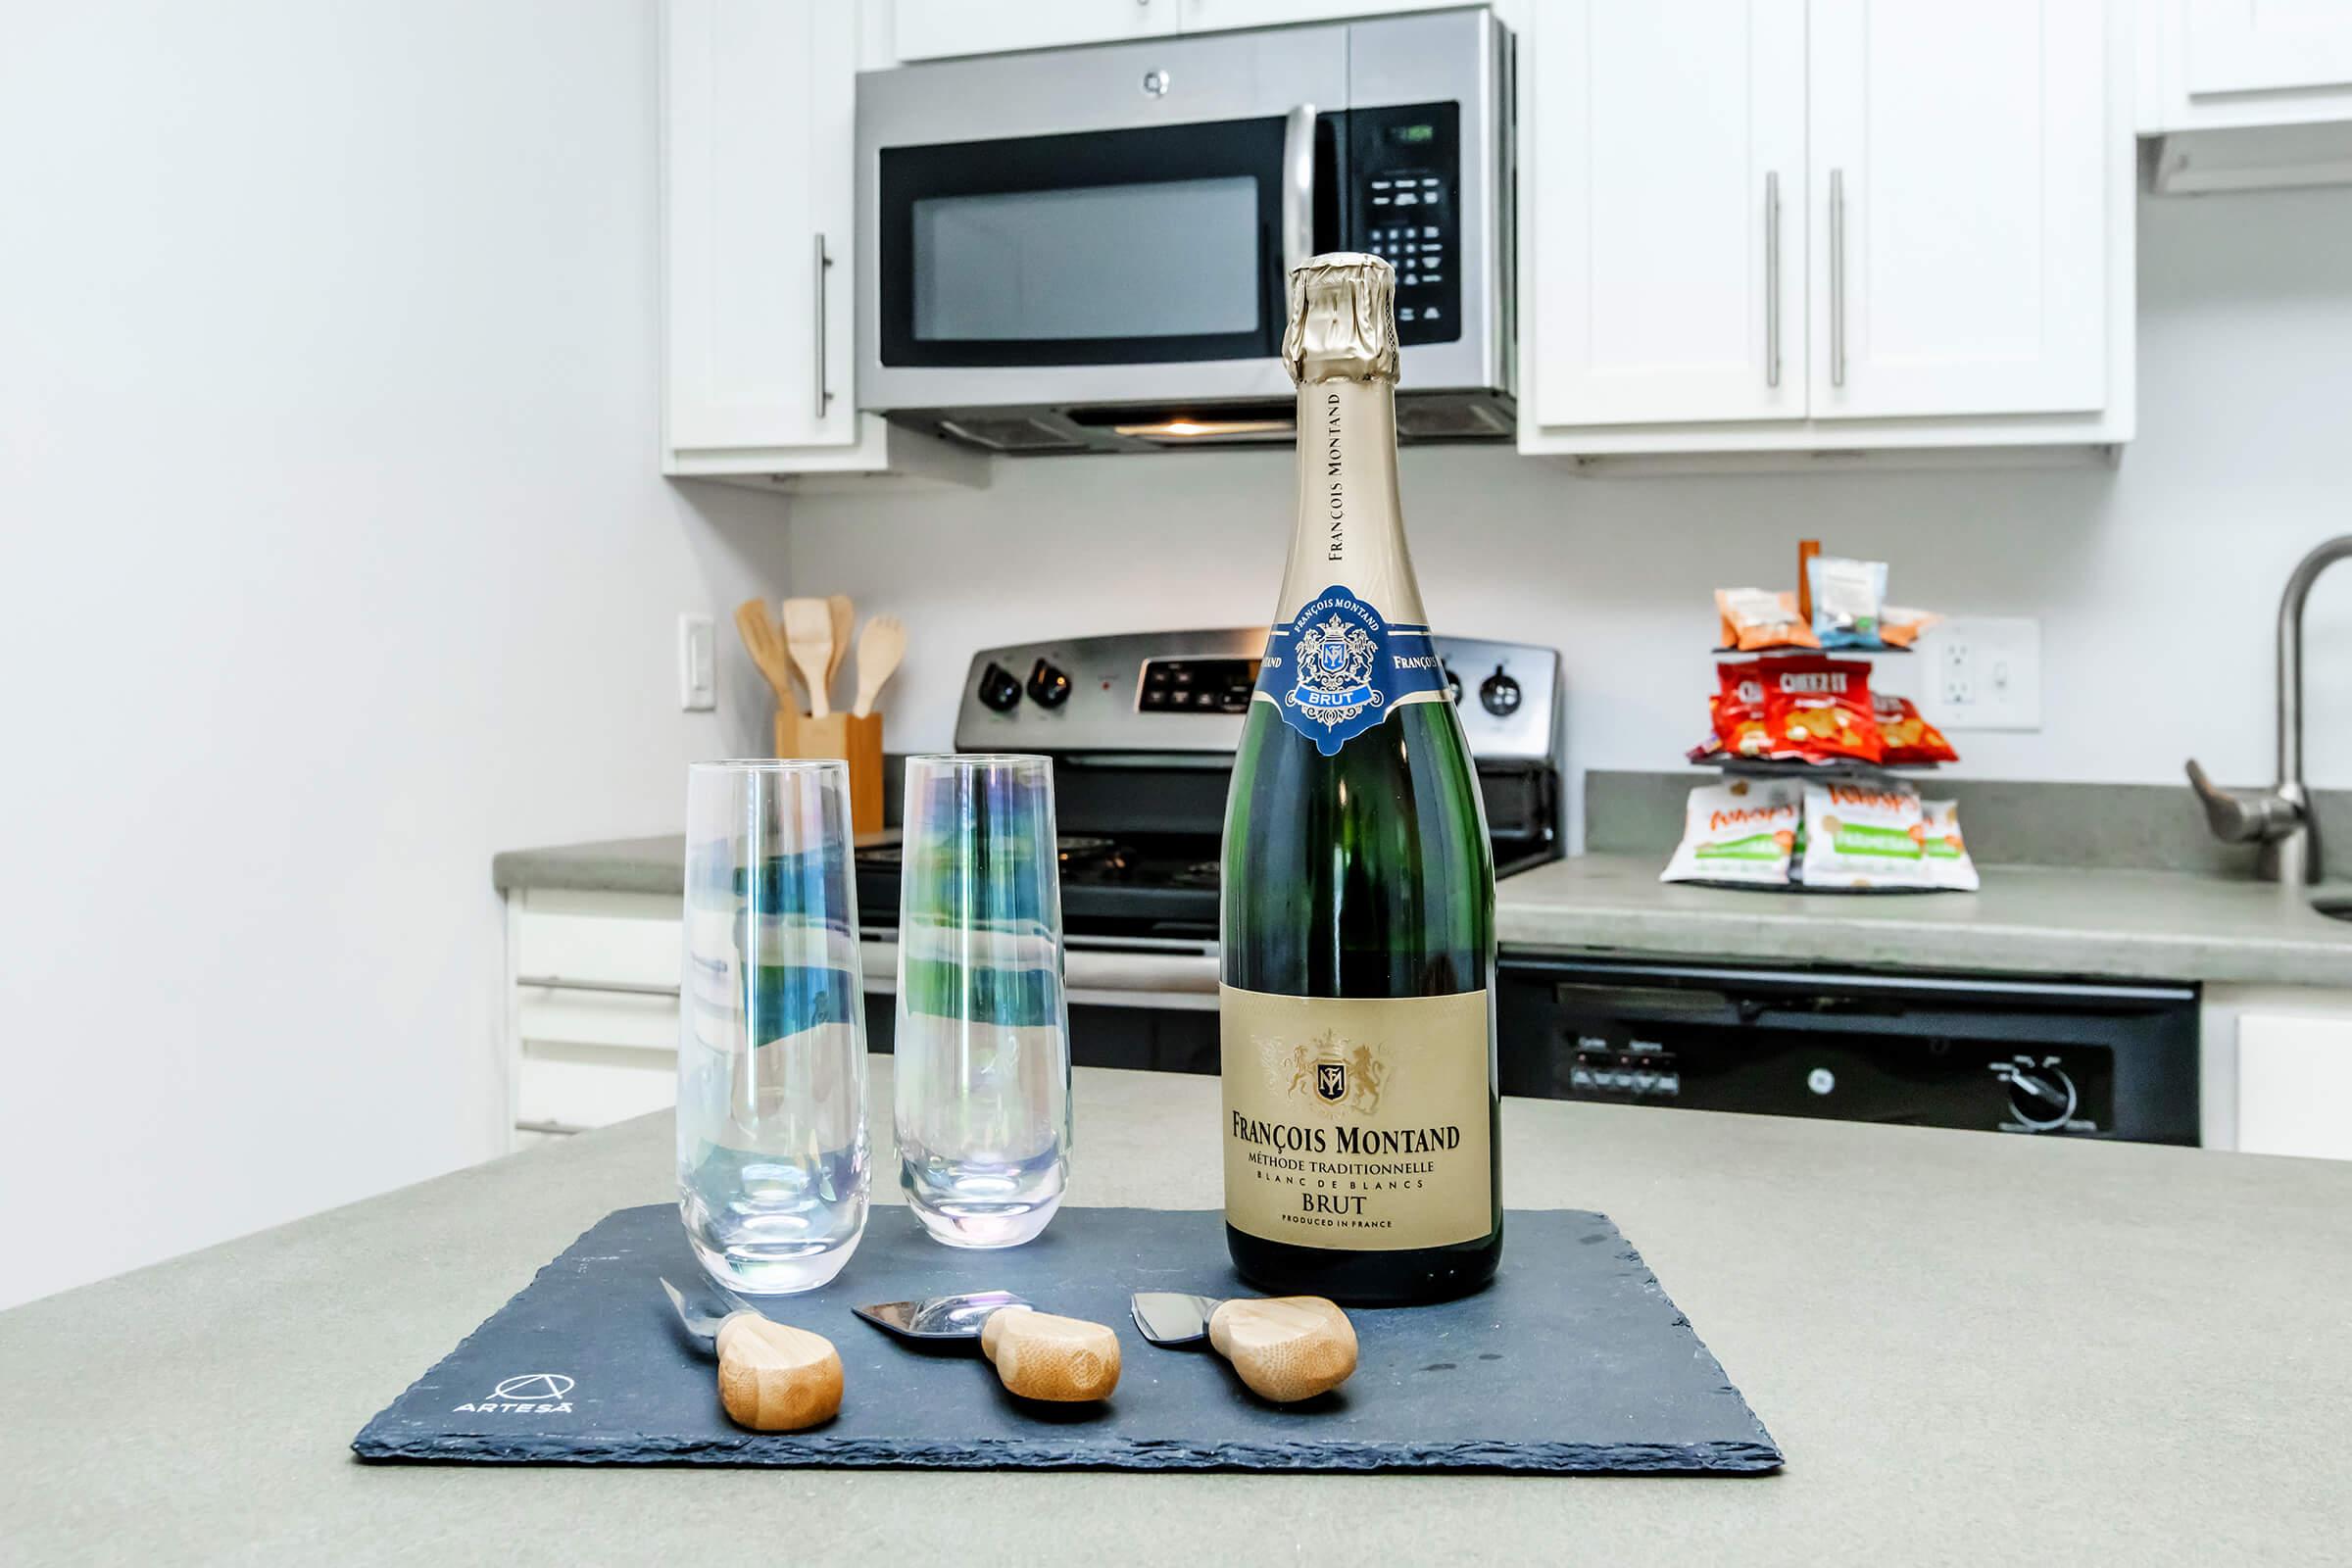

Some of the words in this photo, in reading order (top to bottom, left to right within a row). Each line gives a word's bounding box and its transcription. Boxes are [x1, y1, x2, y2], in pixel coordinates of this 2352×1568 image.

[1328, 394, 1342, 476] MONTAND
[1328, 482, 1344, 562] FRANÇOIS
[1294, 599, 1333, 633] FRANÇOIS
[1335, 599, 1380, 631] MONTAND
[1308, 691, 1355, 707] BRUT
[1232, 1109, 1327, 1153] FRANÇOIS
[1336, 1125, 1460, 1154] MONTAND
[1248, 1152, 1305, 1172] MÉTHODE
[1309, 1160, 1435, 1175] TRADITIONNELLE
[1257, 1171, 1306, 1187] BLANC
[1317, 1179, 1338, 1190] DE
[1349, 1179, 1424, 1191] BLANCS
[1301, 1193, 1367, 1215] BRUT
[1282, 1214, 1334, 1227] PRODUCED
[1351, 1220, 1393, 1229] FRANCE
